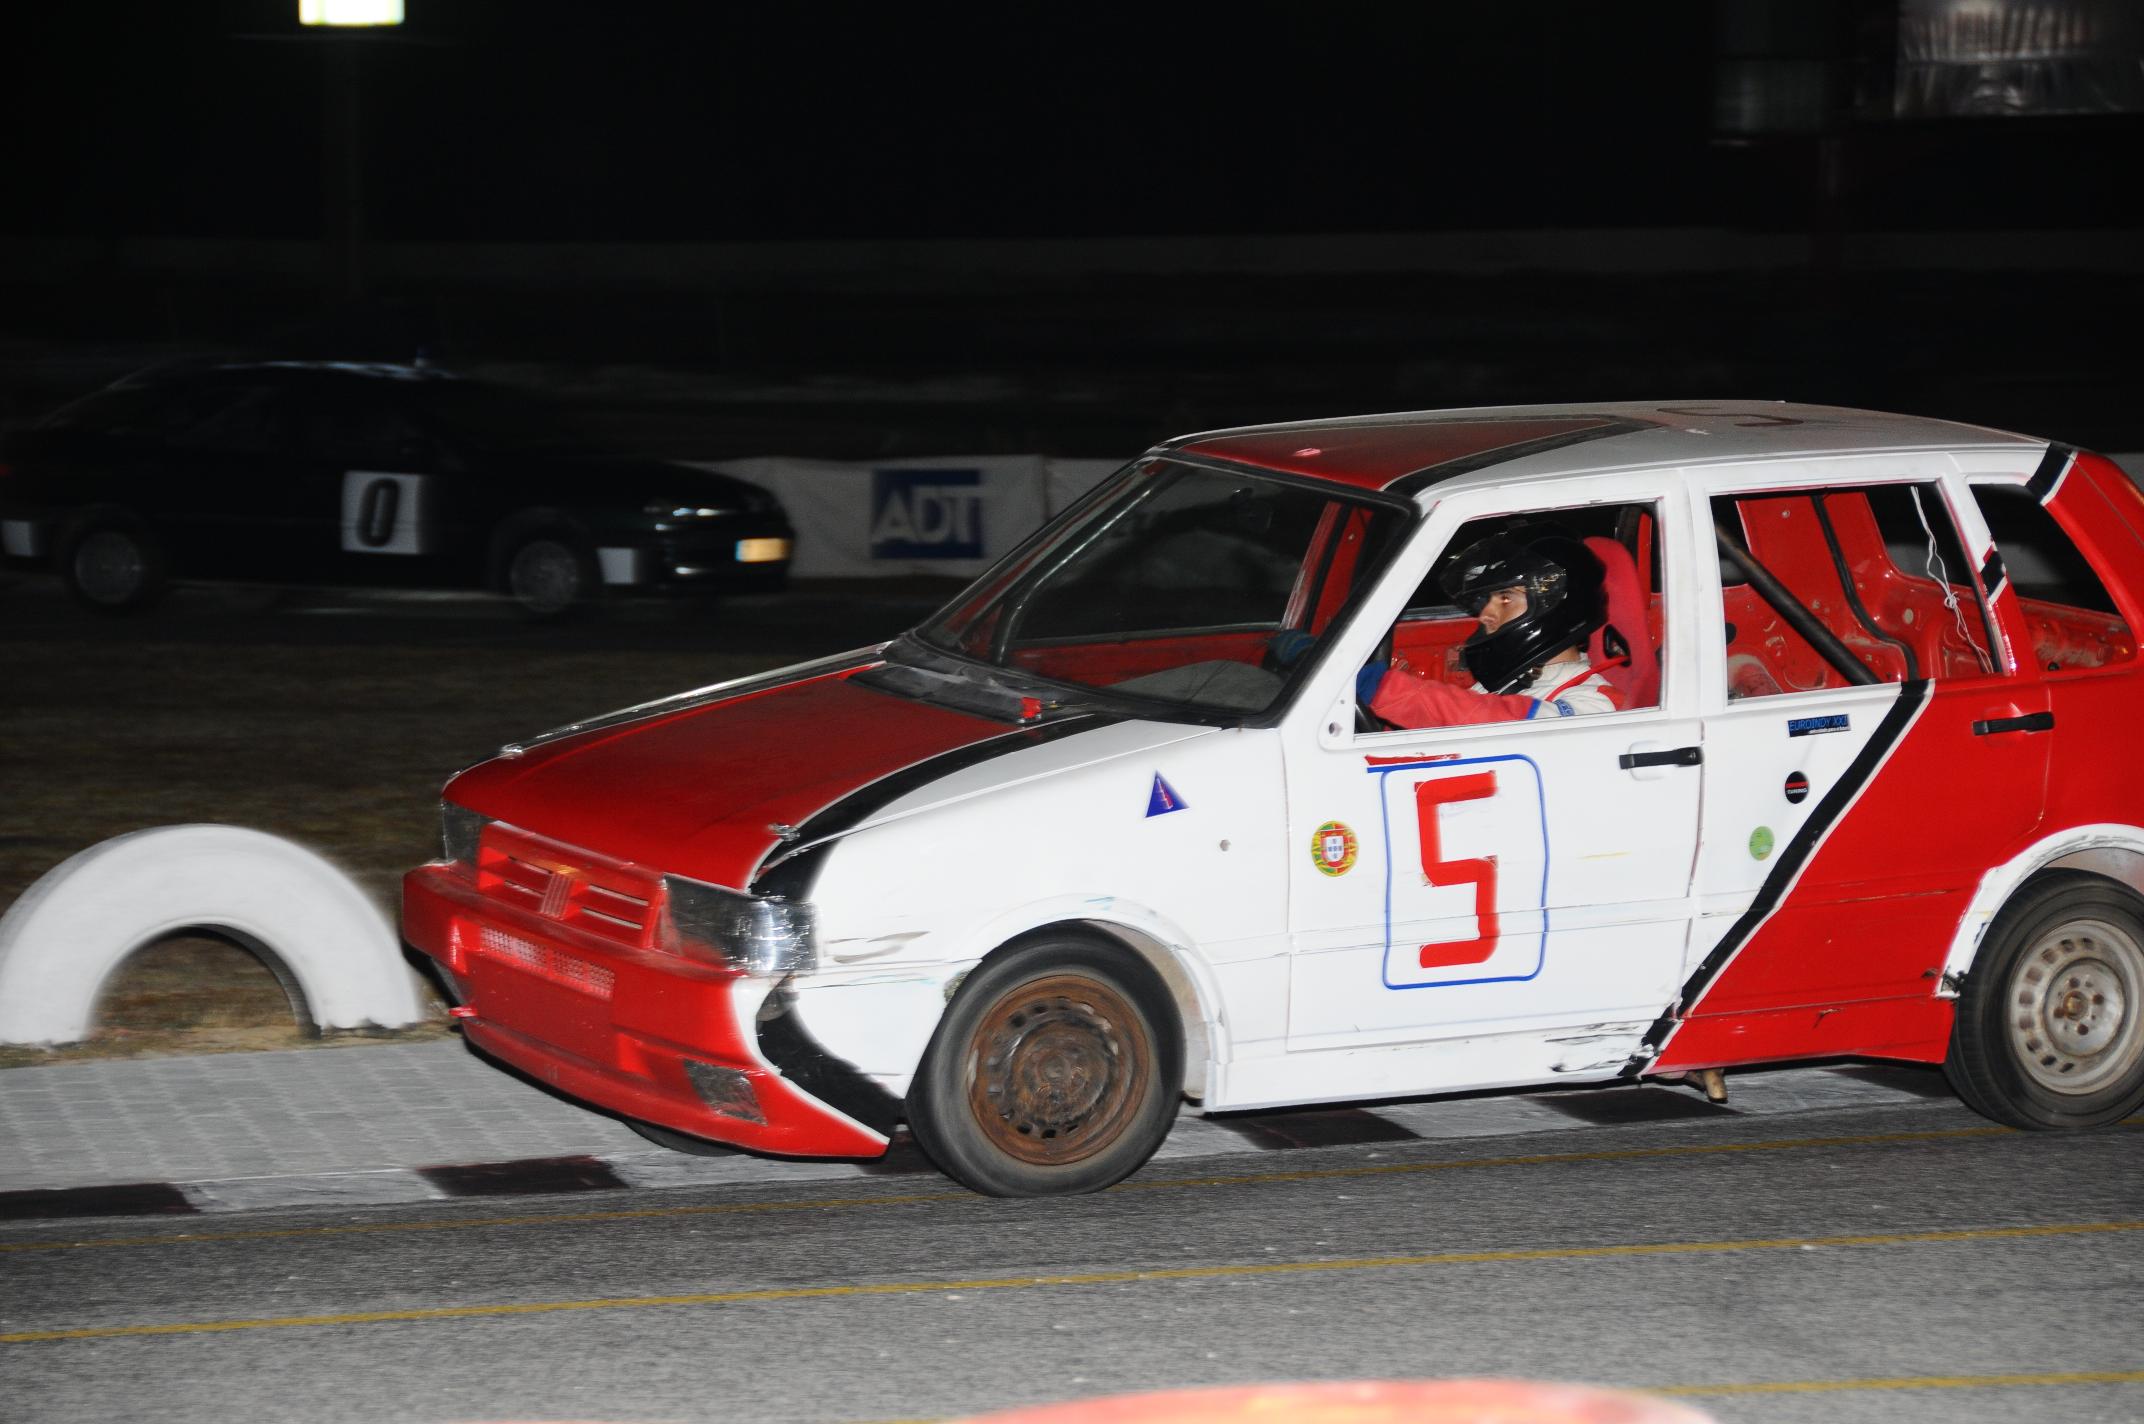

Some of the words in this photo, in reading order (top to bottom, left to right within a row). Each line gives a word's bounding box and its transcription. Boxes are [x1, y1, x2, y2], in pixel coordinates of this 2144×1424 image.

[357, 477, 401, 548] 0
[871, 485, 987, 545] ADT
[1414, 770, 1500, 969] 5
